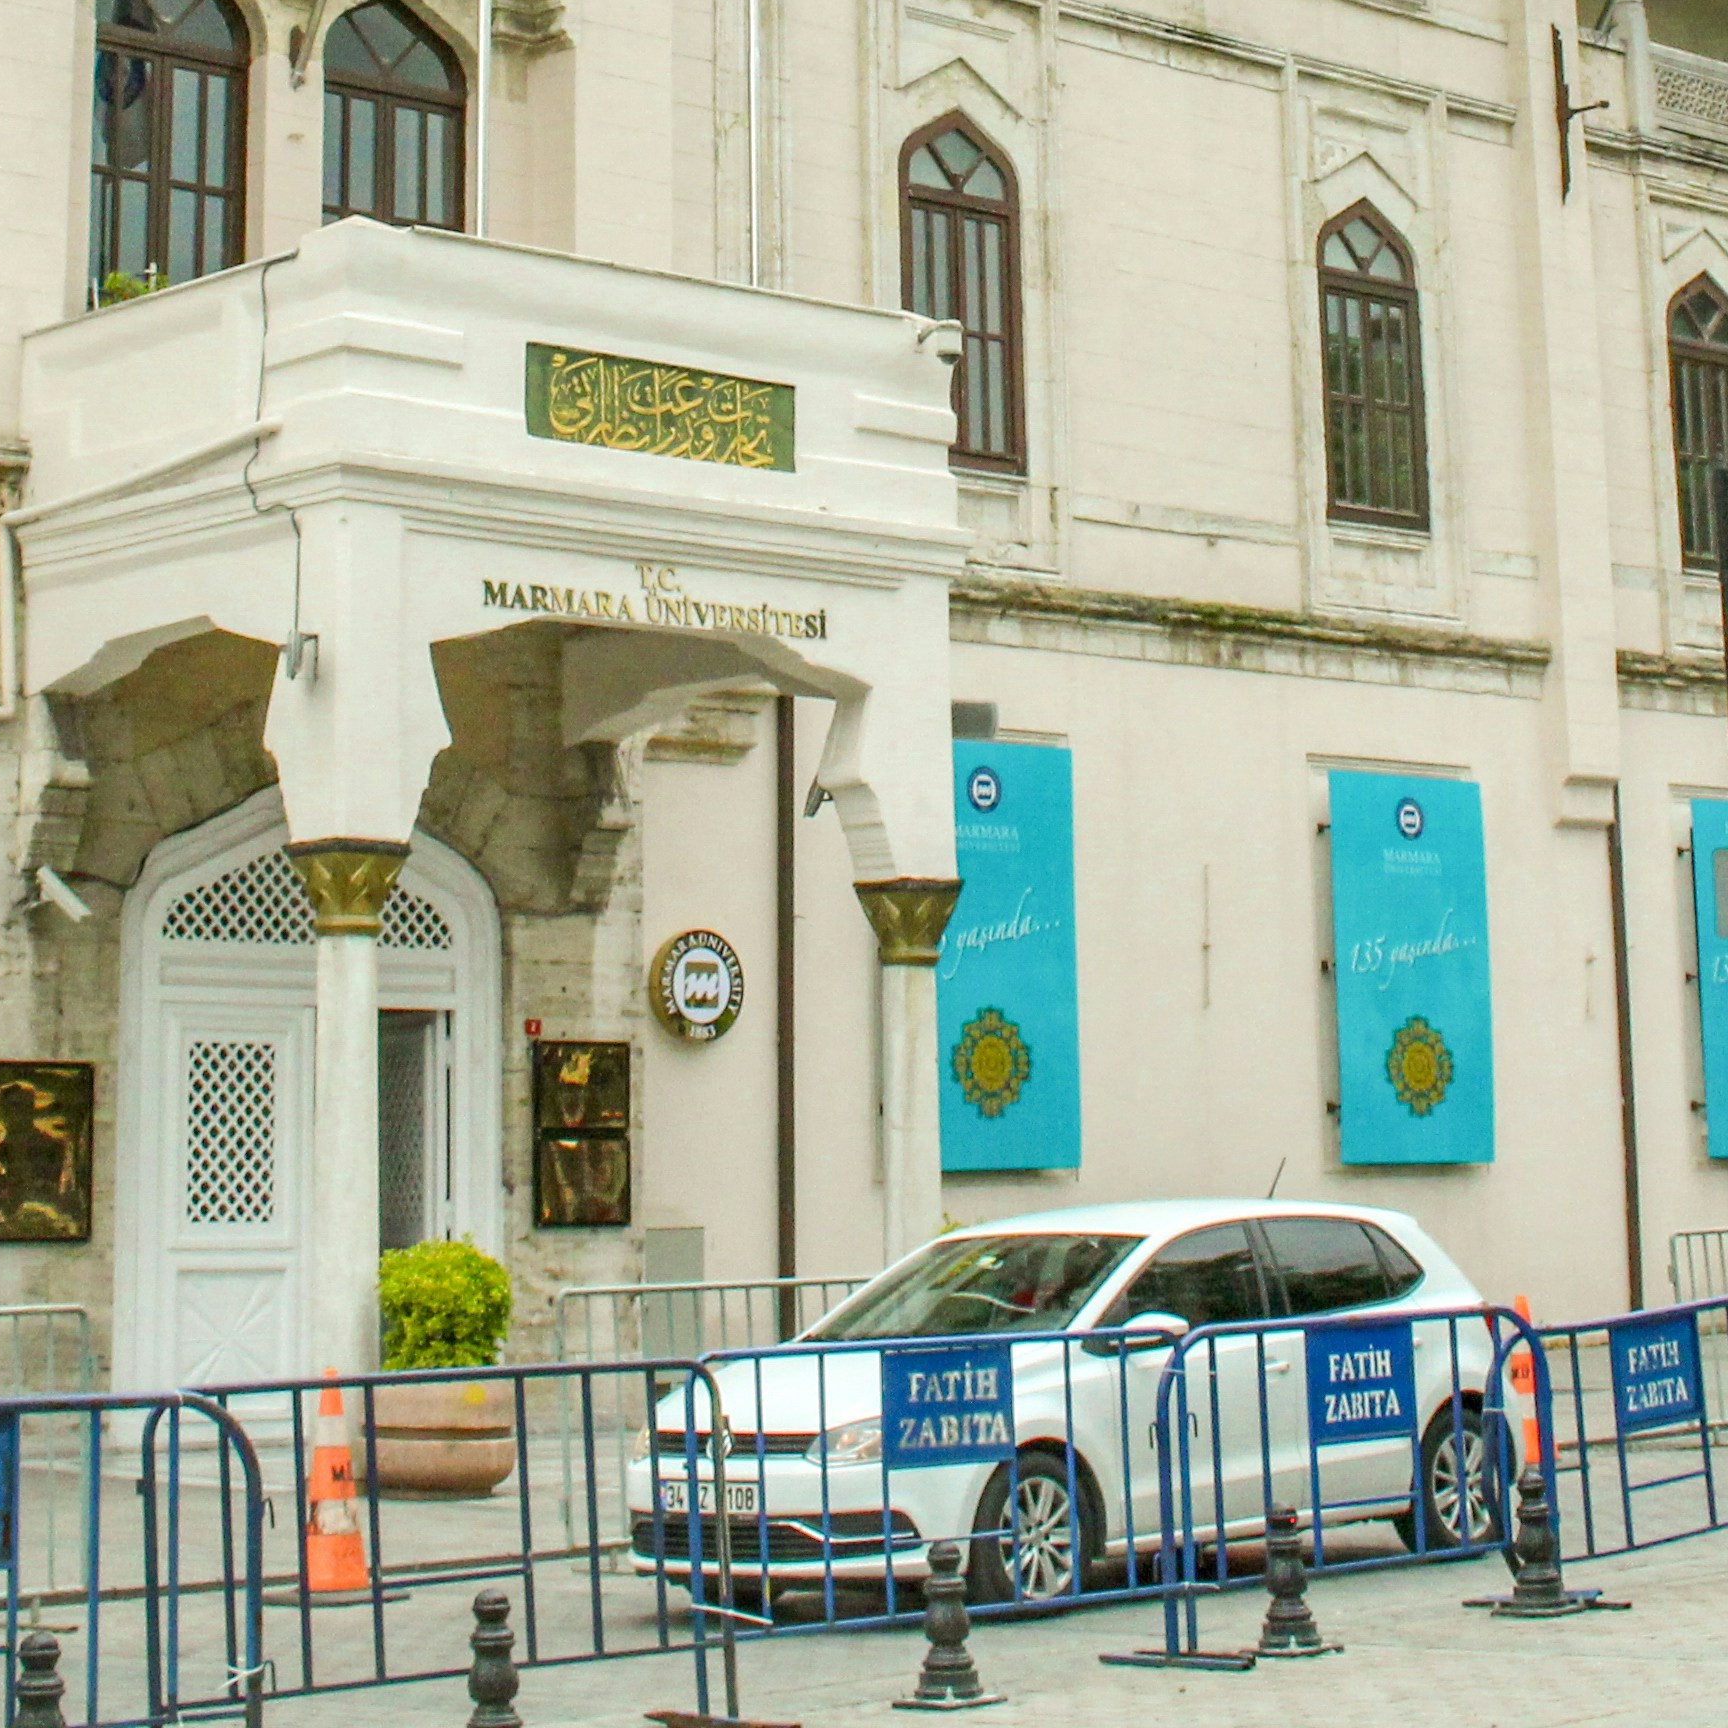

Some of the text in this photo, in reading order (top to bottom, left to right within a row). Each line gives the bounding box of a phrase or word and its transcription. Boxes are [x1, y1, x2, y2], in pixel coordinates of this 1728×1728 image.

[634, 562, 683, 593] T.C.
[482, 578, 828, 640] MARMARA ÜNİVERSİTESİ
[1352, 931, 1387, 974] 135
[1328, 1344, 1392, 1383] FATİH
[1627, 1336, 1680, 1374] FATİH
[907, 1360, 999, 1403] FATİH
[1626, 1376, 1689, 1412] ZABITA
[1324, 1387, 1401, 1424] ZABITA
[899, 1410, 1011, 1450] ZABITA
[727, 1487, 754, 1510] 108
